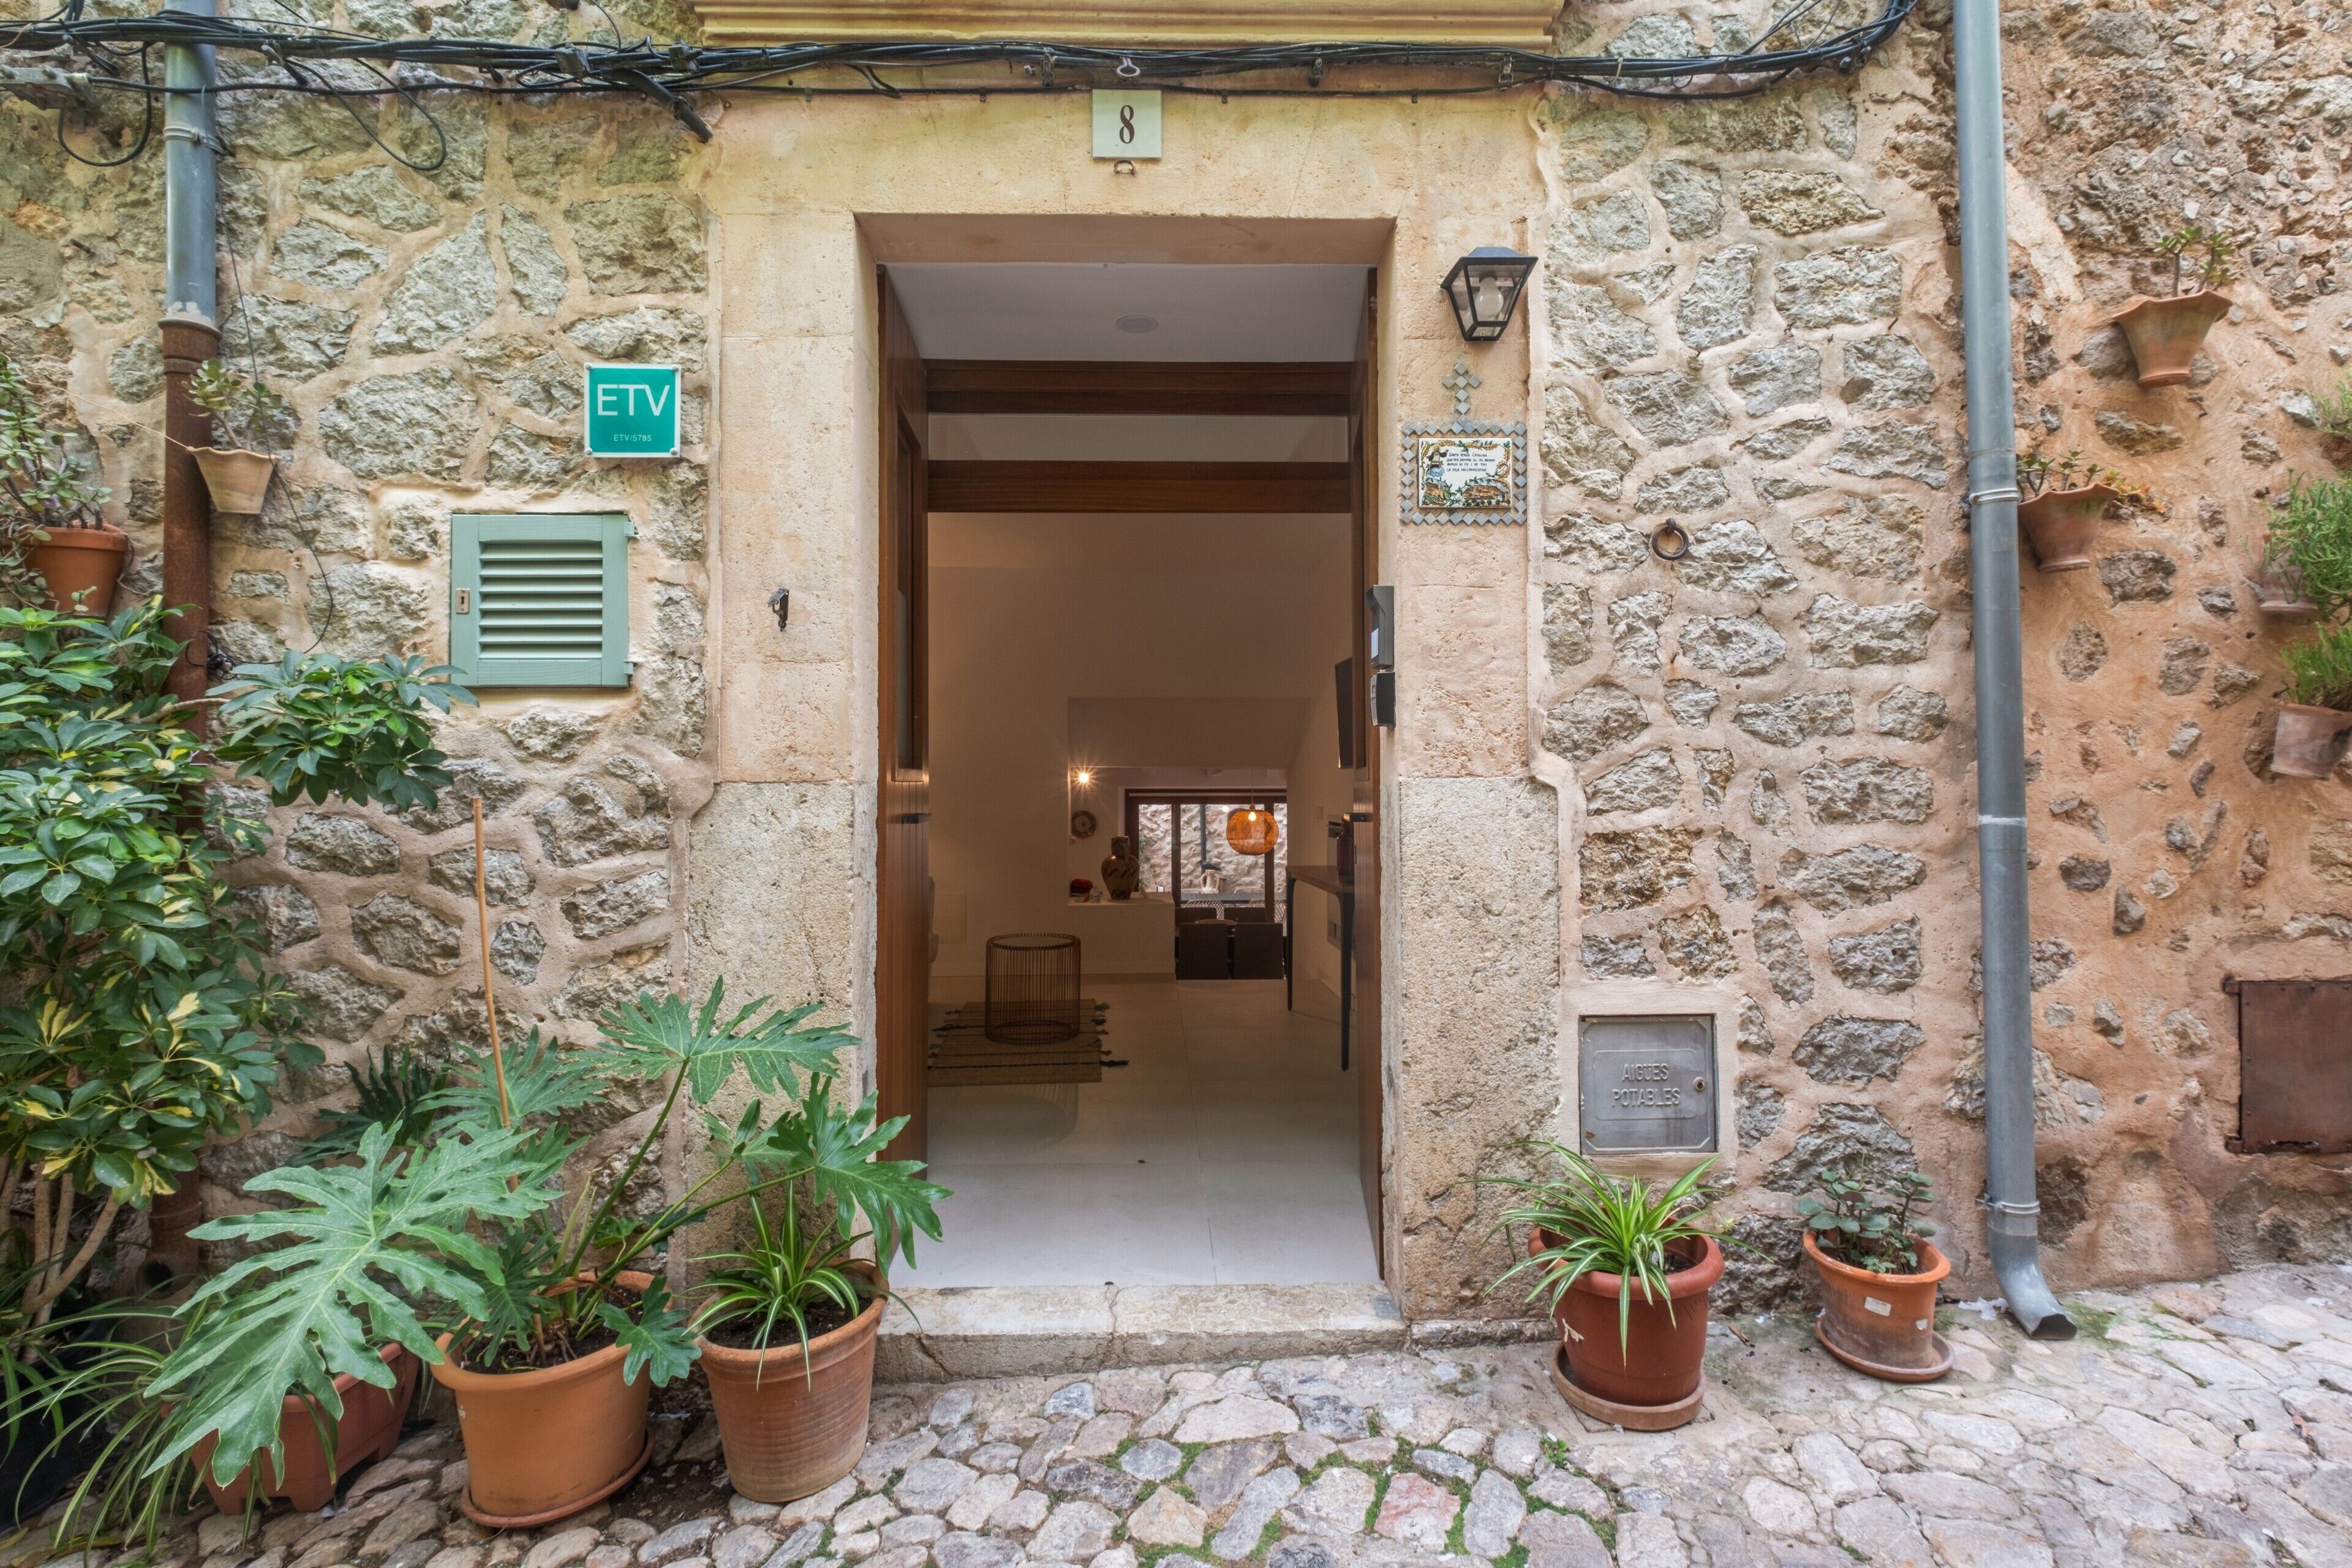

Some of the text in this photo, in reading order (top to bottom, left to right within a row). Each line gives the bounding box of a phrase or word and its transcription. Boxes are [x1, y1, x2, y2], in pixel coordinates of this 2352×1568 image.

[1119, 105, 1135, 144] 8
[597, 384, 670, 417] ETV
[1611, 1087, 1681, 1108] POTABLES
